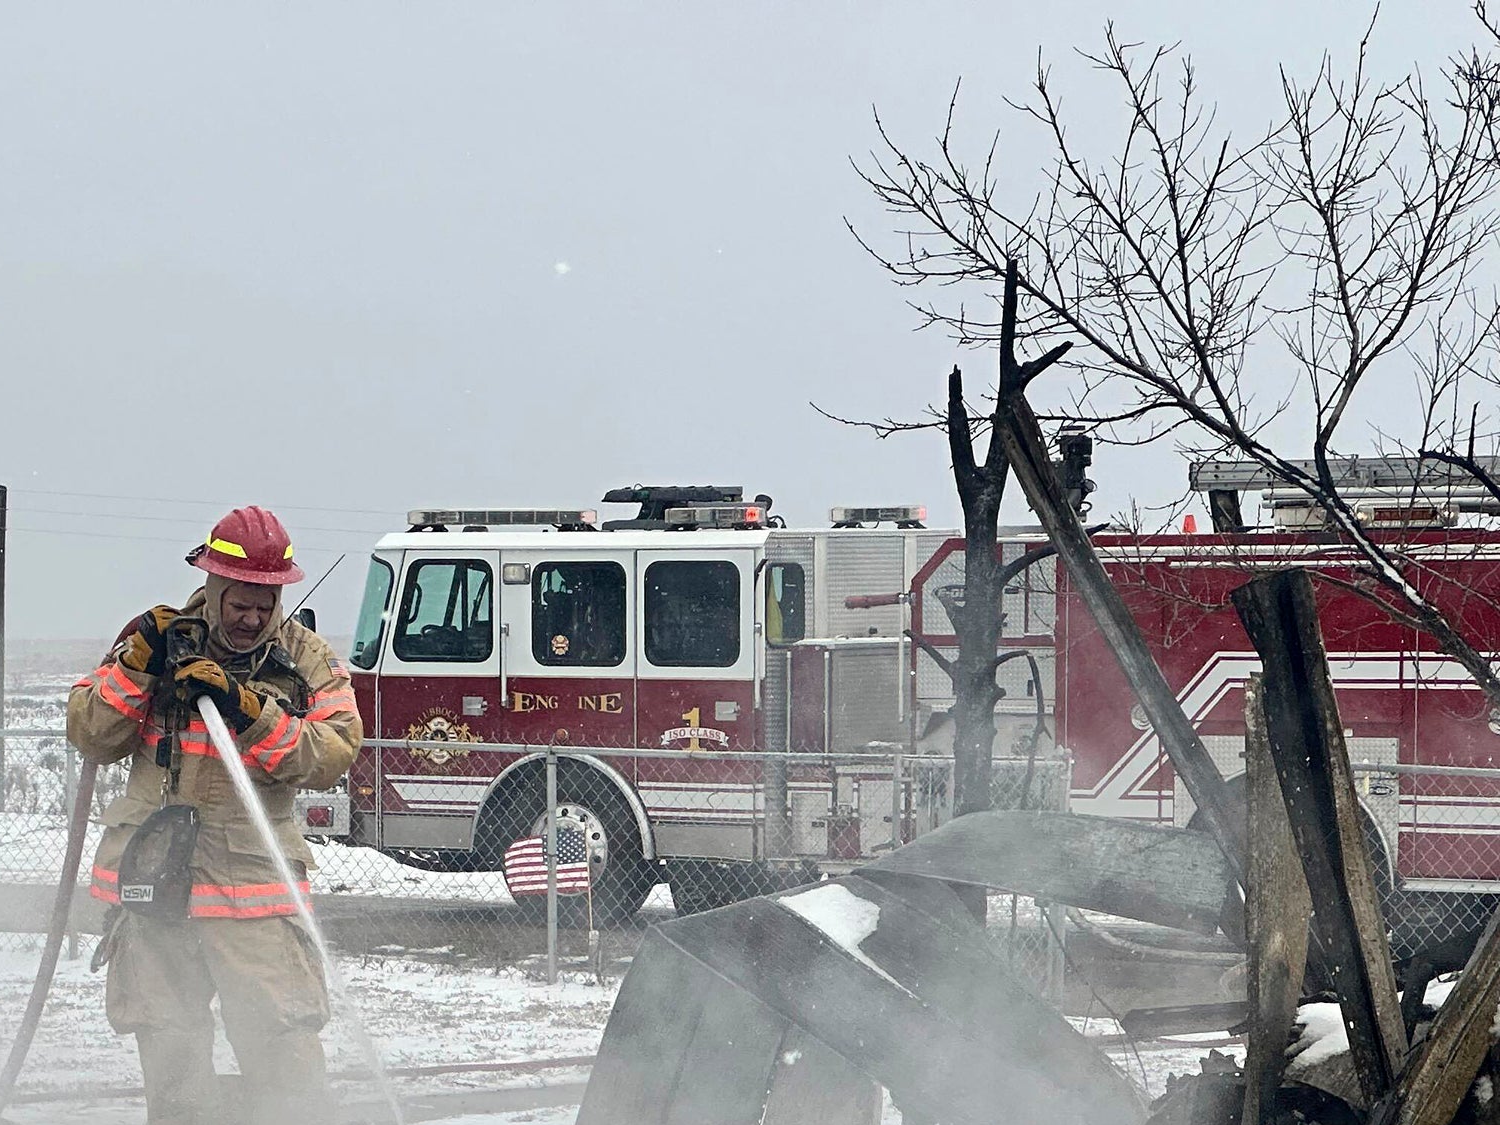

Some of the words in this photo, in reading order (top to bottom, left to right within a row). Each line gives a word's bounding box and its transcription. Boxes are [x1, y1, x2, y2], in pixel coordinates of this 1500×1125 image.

[669, 729, 686, 739] ISO
[690, 729, 722, 740] CLASS
[681, 707, 708, 752] 1
